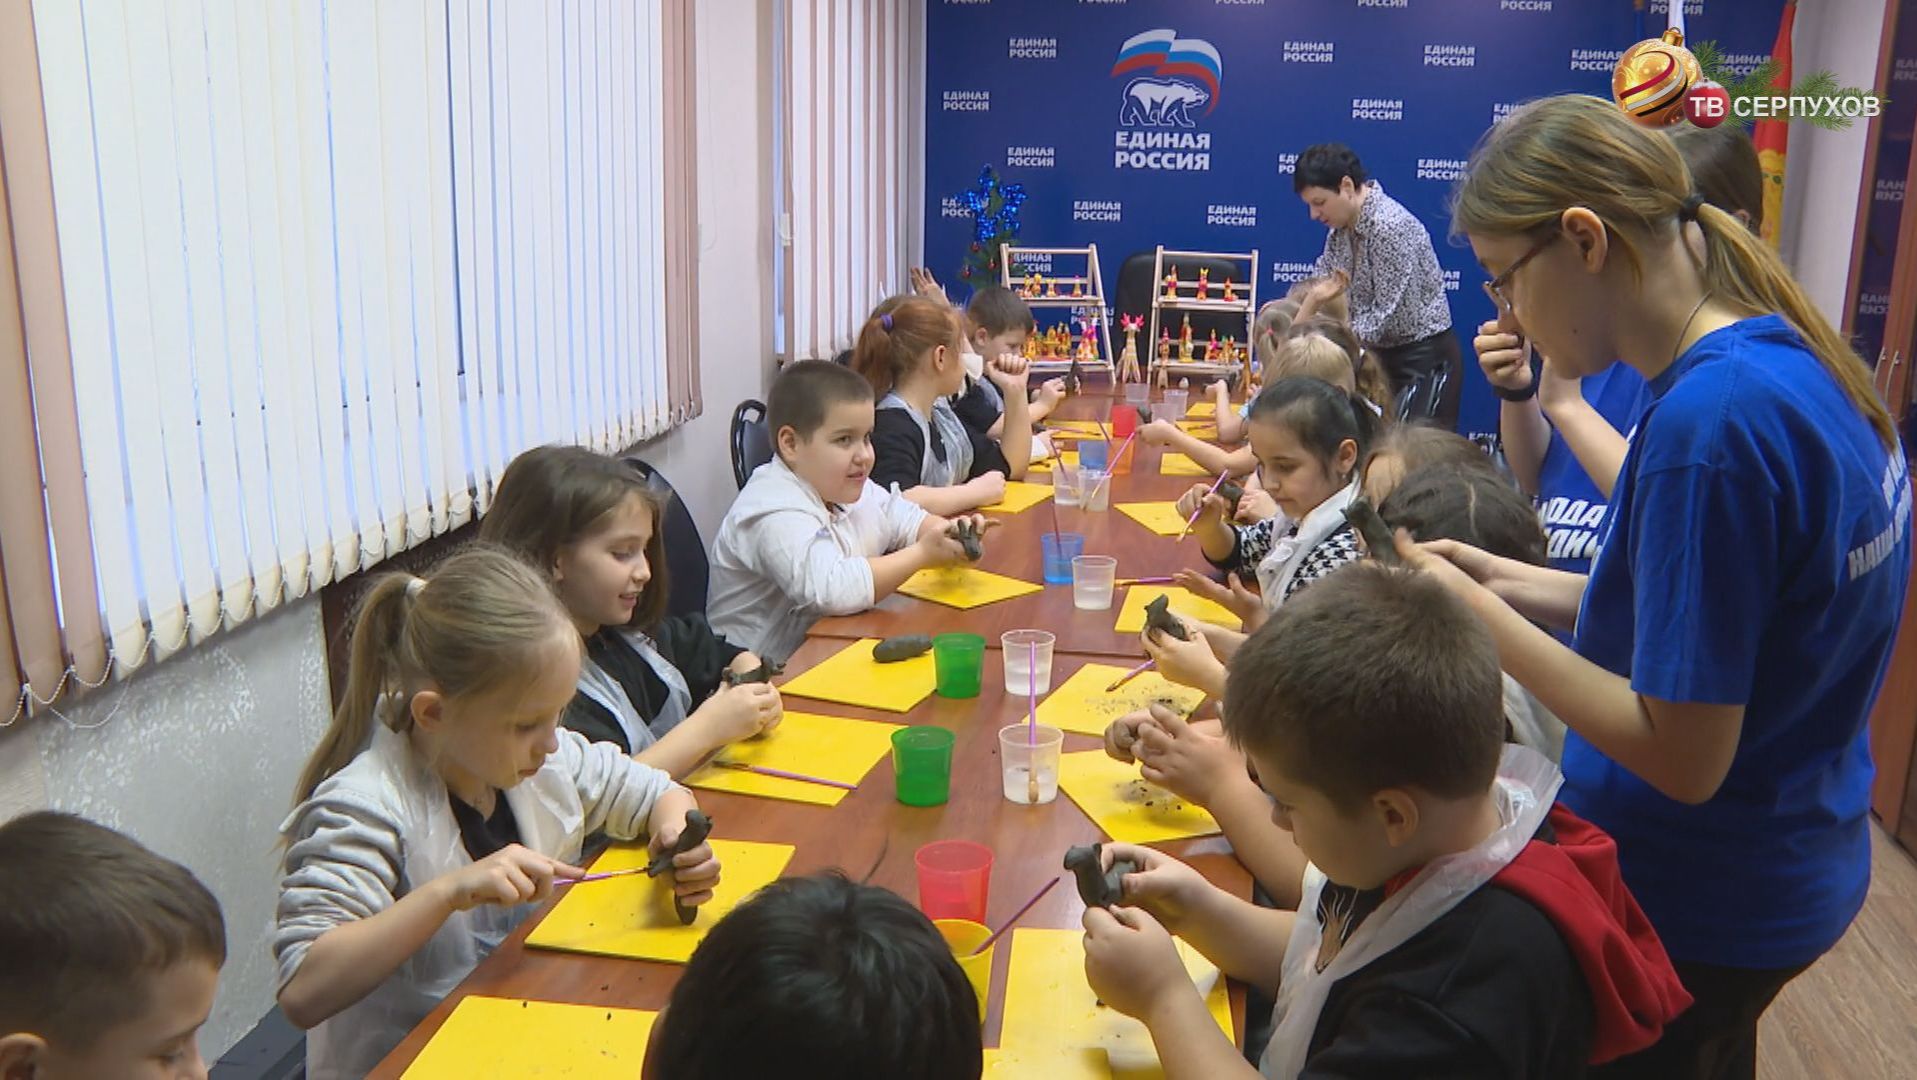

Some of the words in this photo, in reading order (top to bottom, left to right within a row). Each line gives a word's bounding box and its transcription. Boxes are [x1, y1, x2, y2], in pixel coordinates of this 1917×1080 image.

[1501, 0, 1552, 10] РОССИЯ
[1010, 38, 1056, 48] ЕДИНАЯ
[1284, 41, 1333, 52] ЕДИНАЯ
[1010, 48, 1056, 58] РОССИЯ
[1425, 45, 1475, 56] ЕДИНАЯ
[1284, 51, 1333, 63] РОССИЯ
[1424, 55, 1474, 67] РОССИЯ
[1570, 60, 1614, 71] РОССИ
[944, 90, 989, 101] ЕДИНАЯ
[944, 100, 989, 111] РОССИЯ
[1353, 98, 1402, 110] ЕДИНАЯ
[1353, 109, 1402, 120] РОССИЯ
[1116, 130, 1210, 150] ЕДИНАЯ
[1008, 146, 1054, 157] ЕДИНАЯ
[1008, 156, 1054, 167] РОССИЯ
[1115, 150, 1209, 171] РОССИЯ
[1074, 200, 1121, 211] ЕДИНАЯ
[1208, 205, 1256, 215] ЕДИНАЯ
[1074, 210, 1120, 221] РОССИЯ
[1208, 214, 1255, 226] РОССИЯ
[1274, 262, 1314, 272] ЕДИНА
